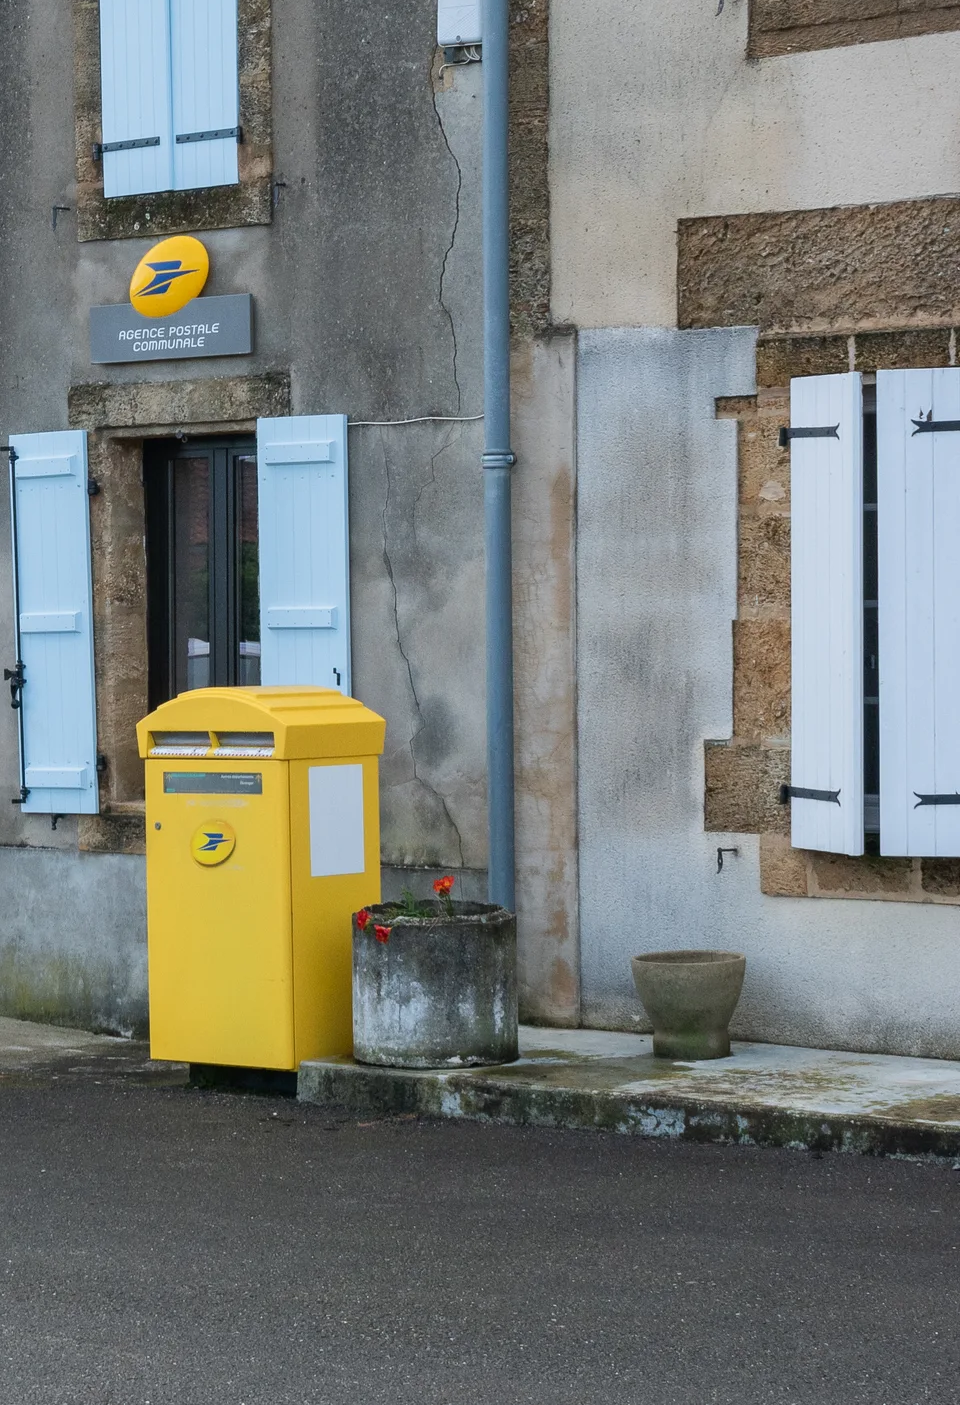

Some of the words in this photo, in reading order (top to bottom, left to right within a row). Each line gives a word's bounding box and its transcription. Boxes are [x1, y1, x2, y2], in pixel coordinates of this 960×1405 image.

[118, 327, 165, 341] AGENCE
[168, 322, 220, 337] POSTALE
[132, 336, 205, 352] COMMUNALE
